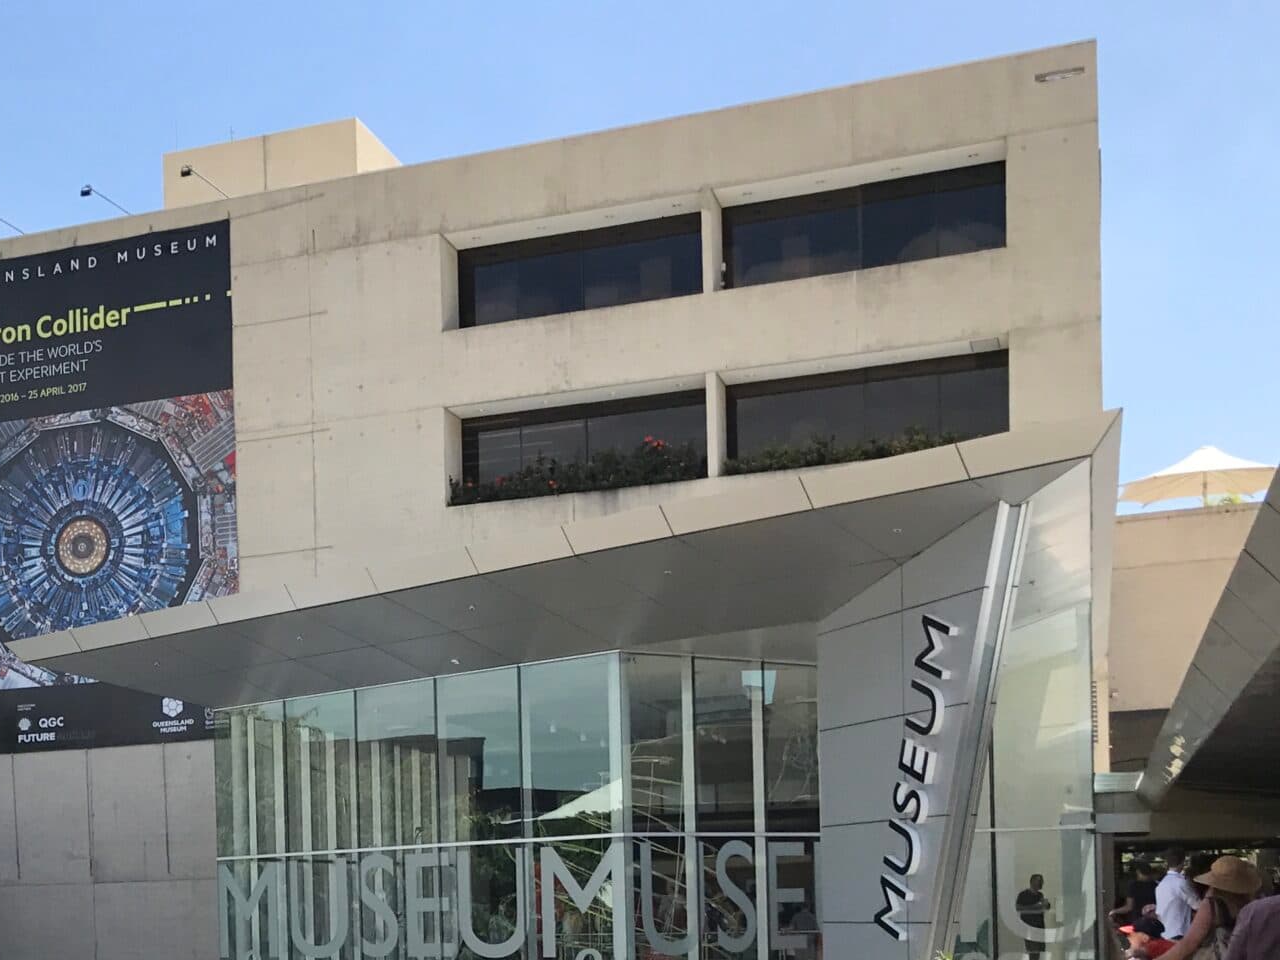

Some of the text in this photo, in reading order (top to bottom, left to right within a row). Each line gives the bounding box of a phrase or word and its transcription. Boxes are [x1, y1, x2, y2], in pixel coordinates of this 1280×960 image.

[116, 234, 219, 264] MUSEUM
[36, 304, 131, 339] Collider
[19, 350, 45, 365] THE
[46, 339, 104, 361] WORLD'S
[9, 359, 89, 383] EXPERIMENT
[0, 392, 20, 405] 2016
[28, 388, 39, 401] 25
[39, 385, 66, 399] APRIL
[67, 382, 88, 396] 2017
[38, 716, 65, 729] QGC
[152, 718, 195, 728] QUEENSLAND
[159, 726, 187, 734] MUSEUM
[18, 732, 56, 744] FUTURE
[874, 614, 959, 940] MUSEUM
[220, 845, 616, 959] MUSEUM
